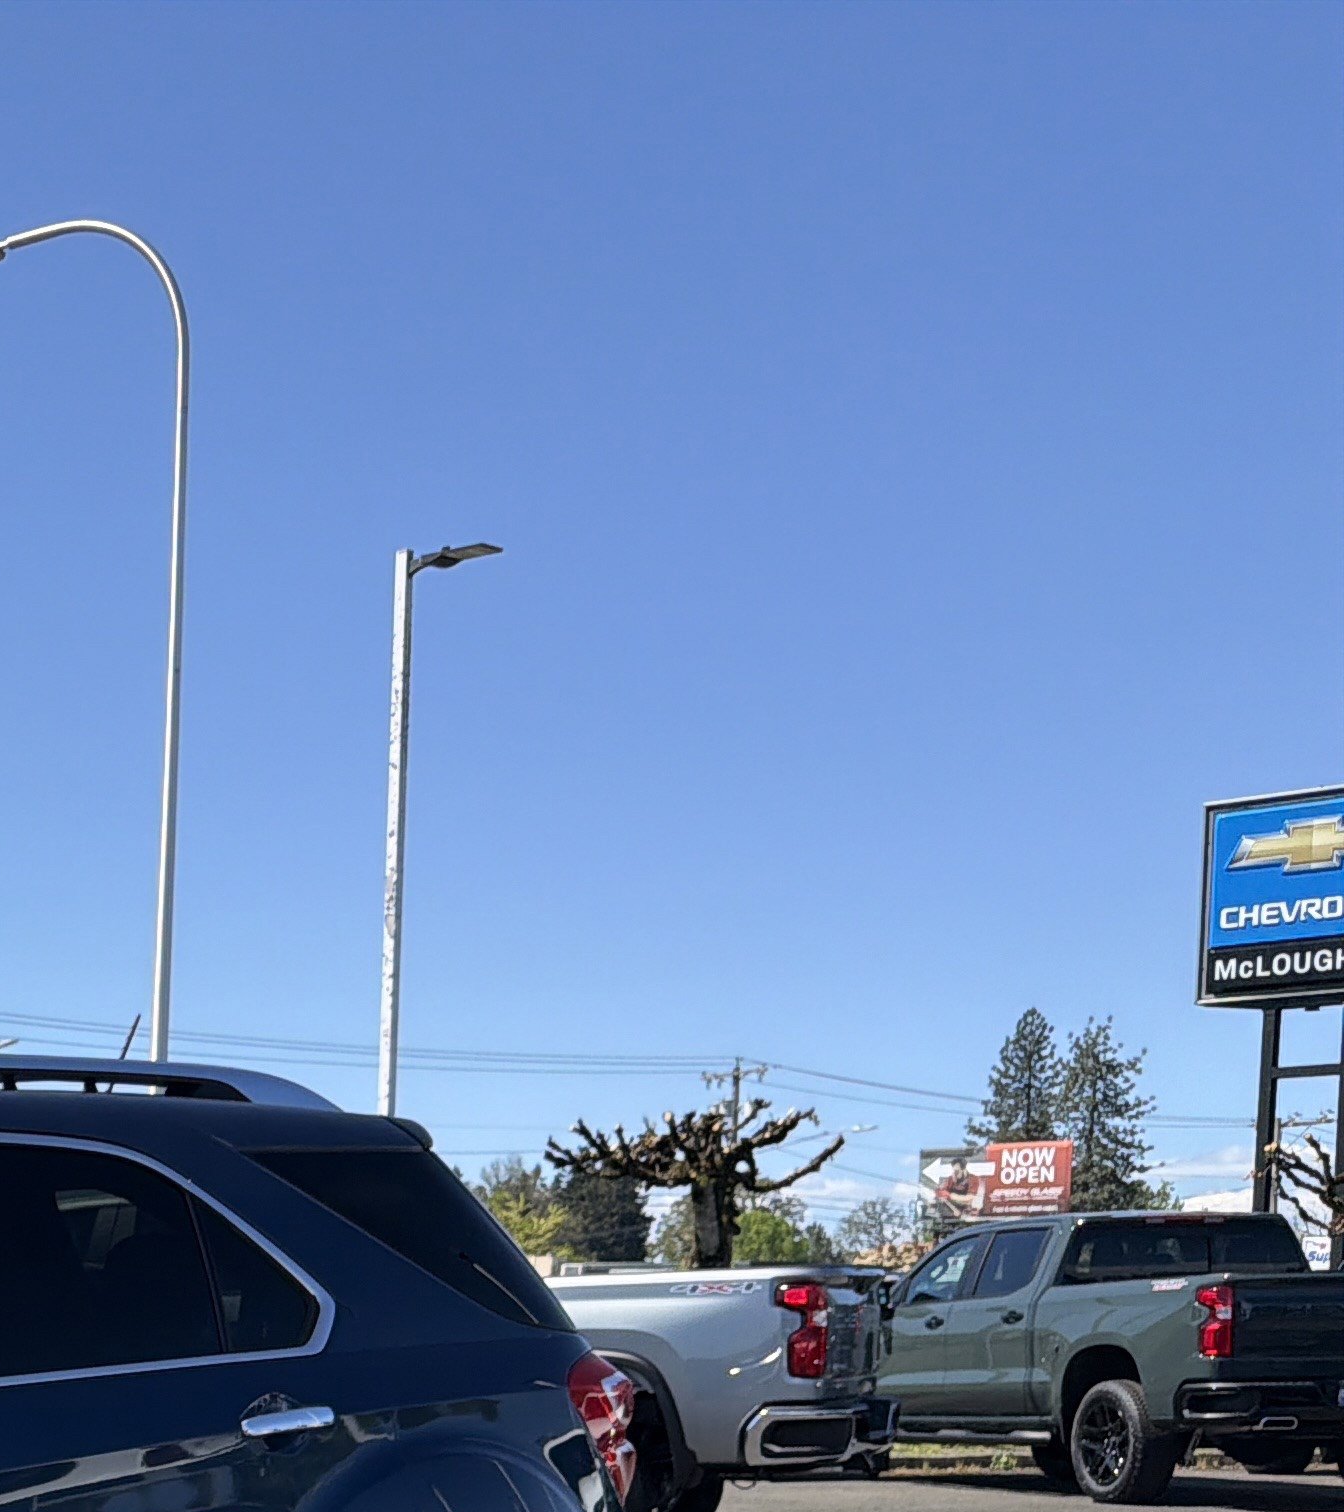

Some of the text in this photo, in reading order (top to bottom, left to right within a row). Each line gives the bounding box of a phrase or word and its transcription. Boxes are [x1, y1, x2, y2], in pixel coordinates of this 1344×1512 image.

[1220, 895, 1344, 929] CHEVRO
[1001, 1147, 1056, 1168] NOW
[1000, 1165, 1055, 1185] OPEN
